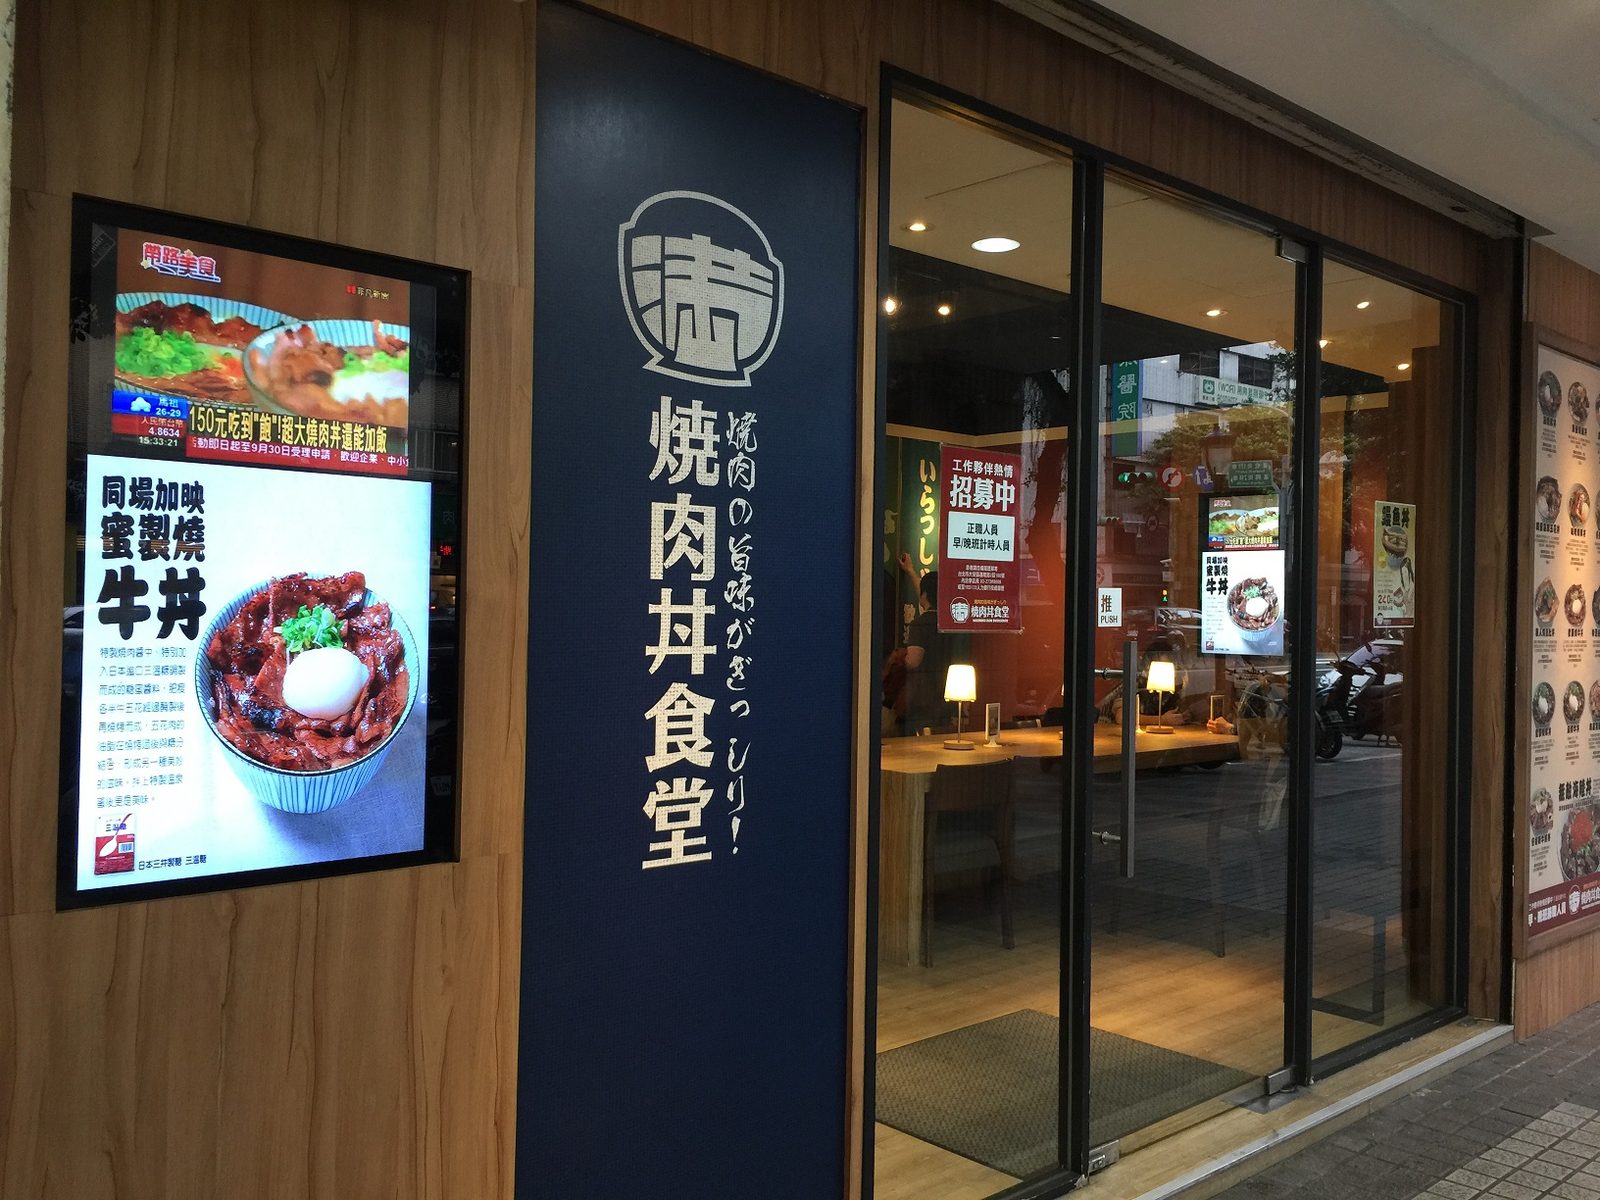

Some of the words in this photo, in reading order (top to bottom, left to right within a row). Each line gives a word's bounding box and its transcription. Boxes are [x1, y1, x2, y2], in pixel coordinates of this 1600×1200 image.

[143, 241, 219, 280] 帶路美食
[156, 408, 181, 417] 26-29
[139, 436, 178, 447] 15:33:21
[148, 427, 180, 437] 4.8634
[952, 459, 1014, 478] 工作夥伴熱情
[102, 475, 205, 514] 同場加映
[950, 475, 1015, 512] 招募中
[100, 511, 205, 562] 蜜製燒
[967, 522, 998, 536] 正職人員
[1206, 577, 1229, 596] 牛丼
[96, 565, 207, 641] 牛丼
[1100, 594, 1112, 613] 推
[1100, 615, 1118, 624] PUSH
[642, 395, 720, 870] 焼肉丼食堂
